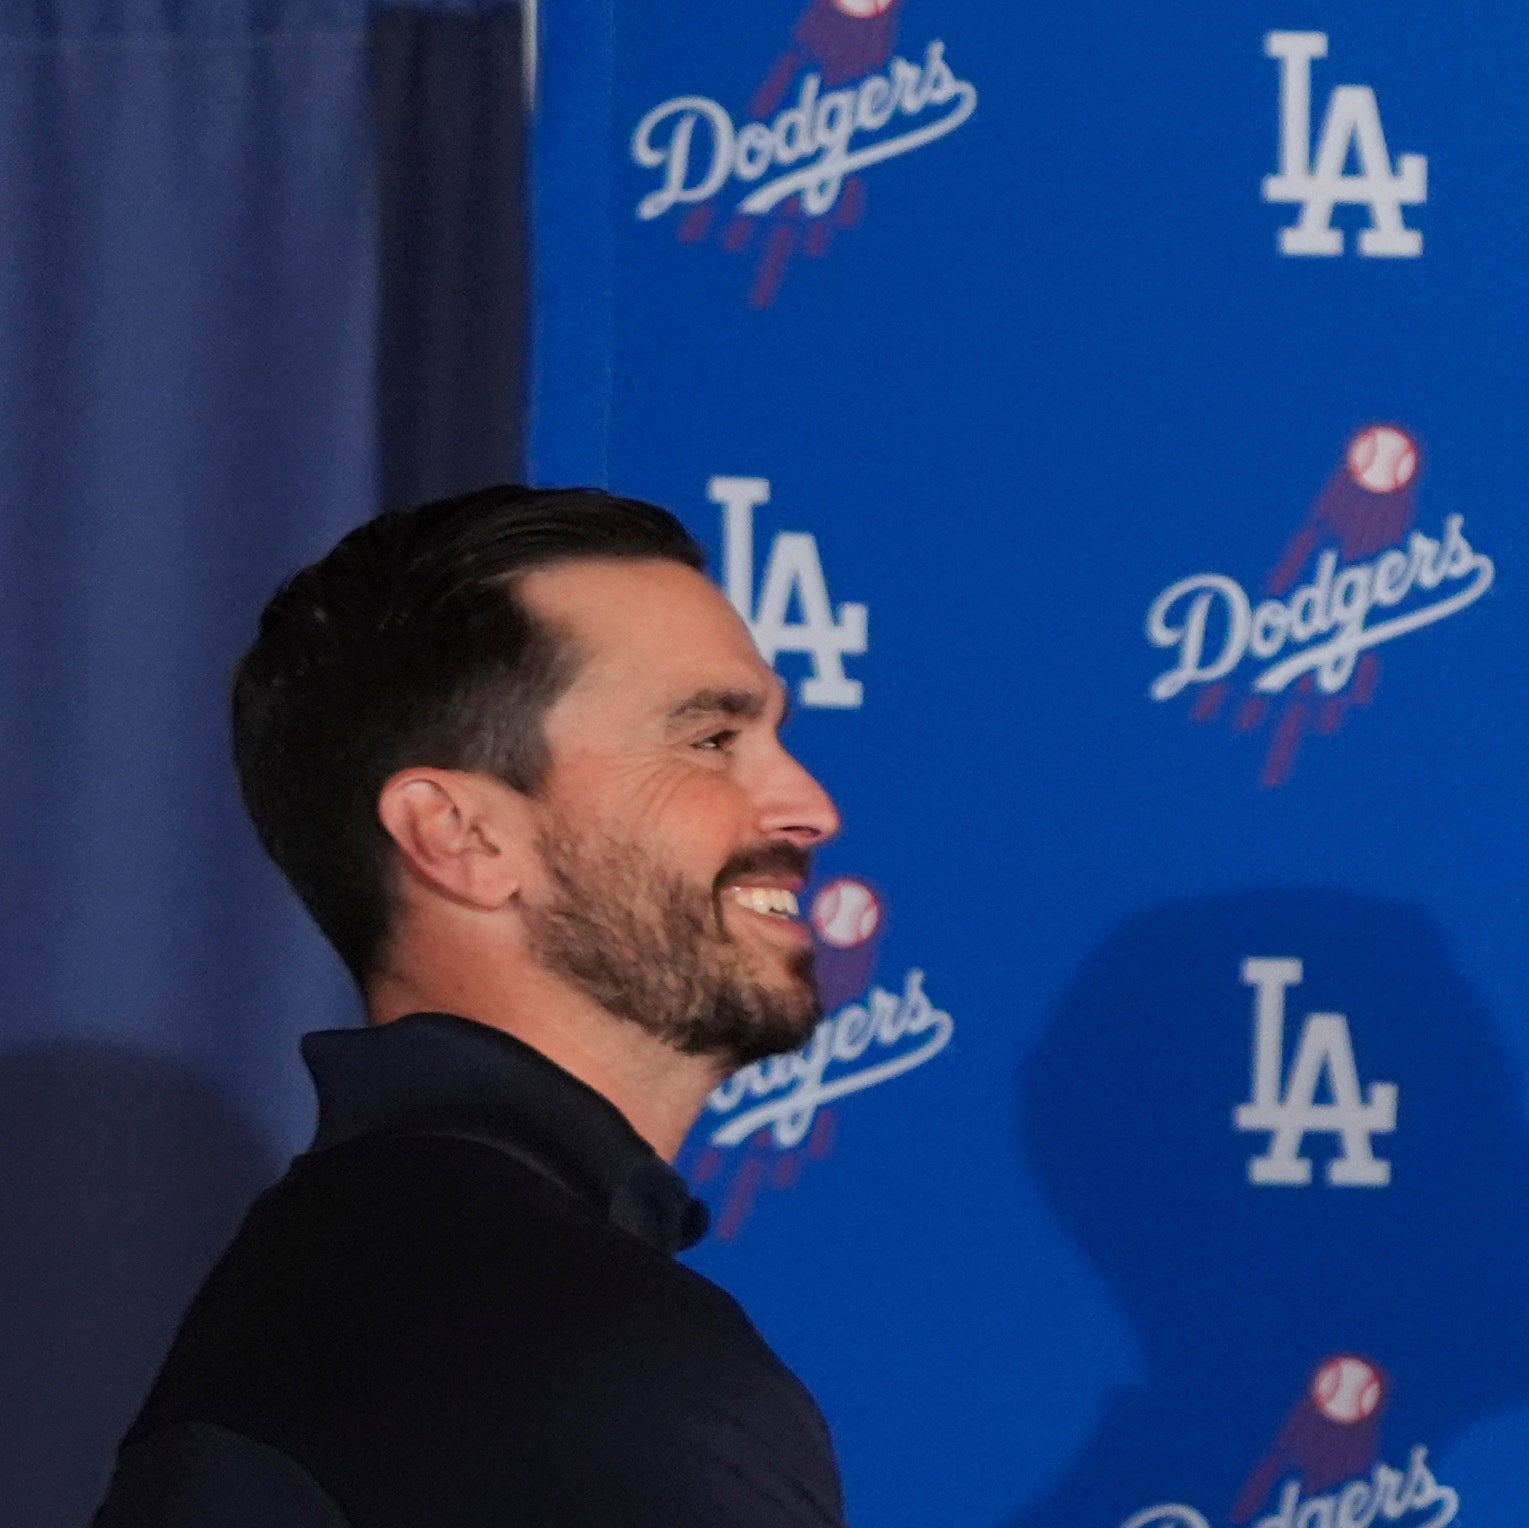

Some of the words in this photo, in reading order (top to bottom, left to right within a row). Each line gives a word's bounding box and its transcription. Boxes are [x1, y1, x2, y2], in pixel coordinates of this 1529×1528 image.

[632, 40, 977, 221] Dodgers
[1262, 31, 1428, 257] LA
[1148, 515, 1495, 701] Dodgers
[1235, 958, 1398, 1186] LA
